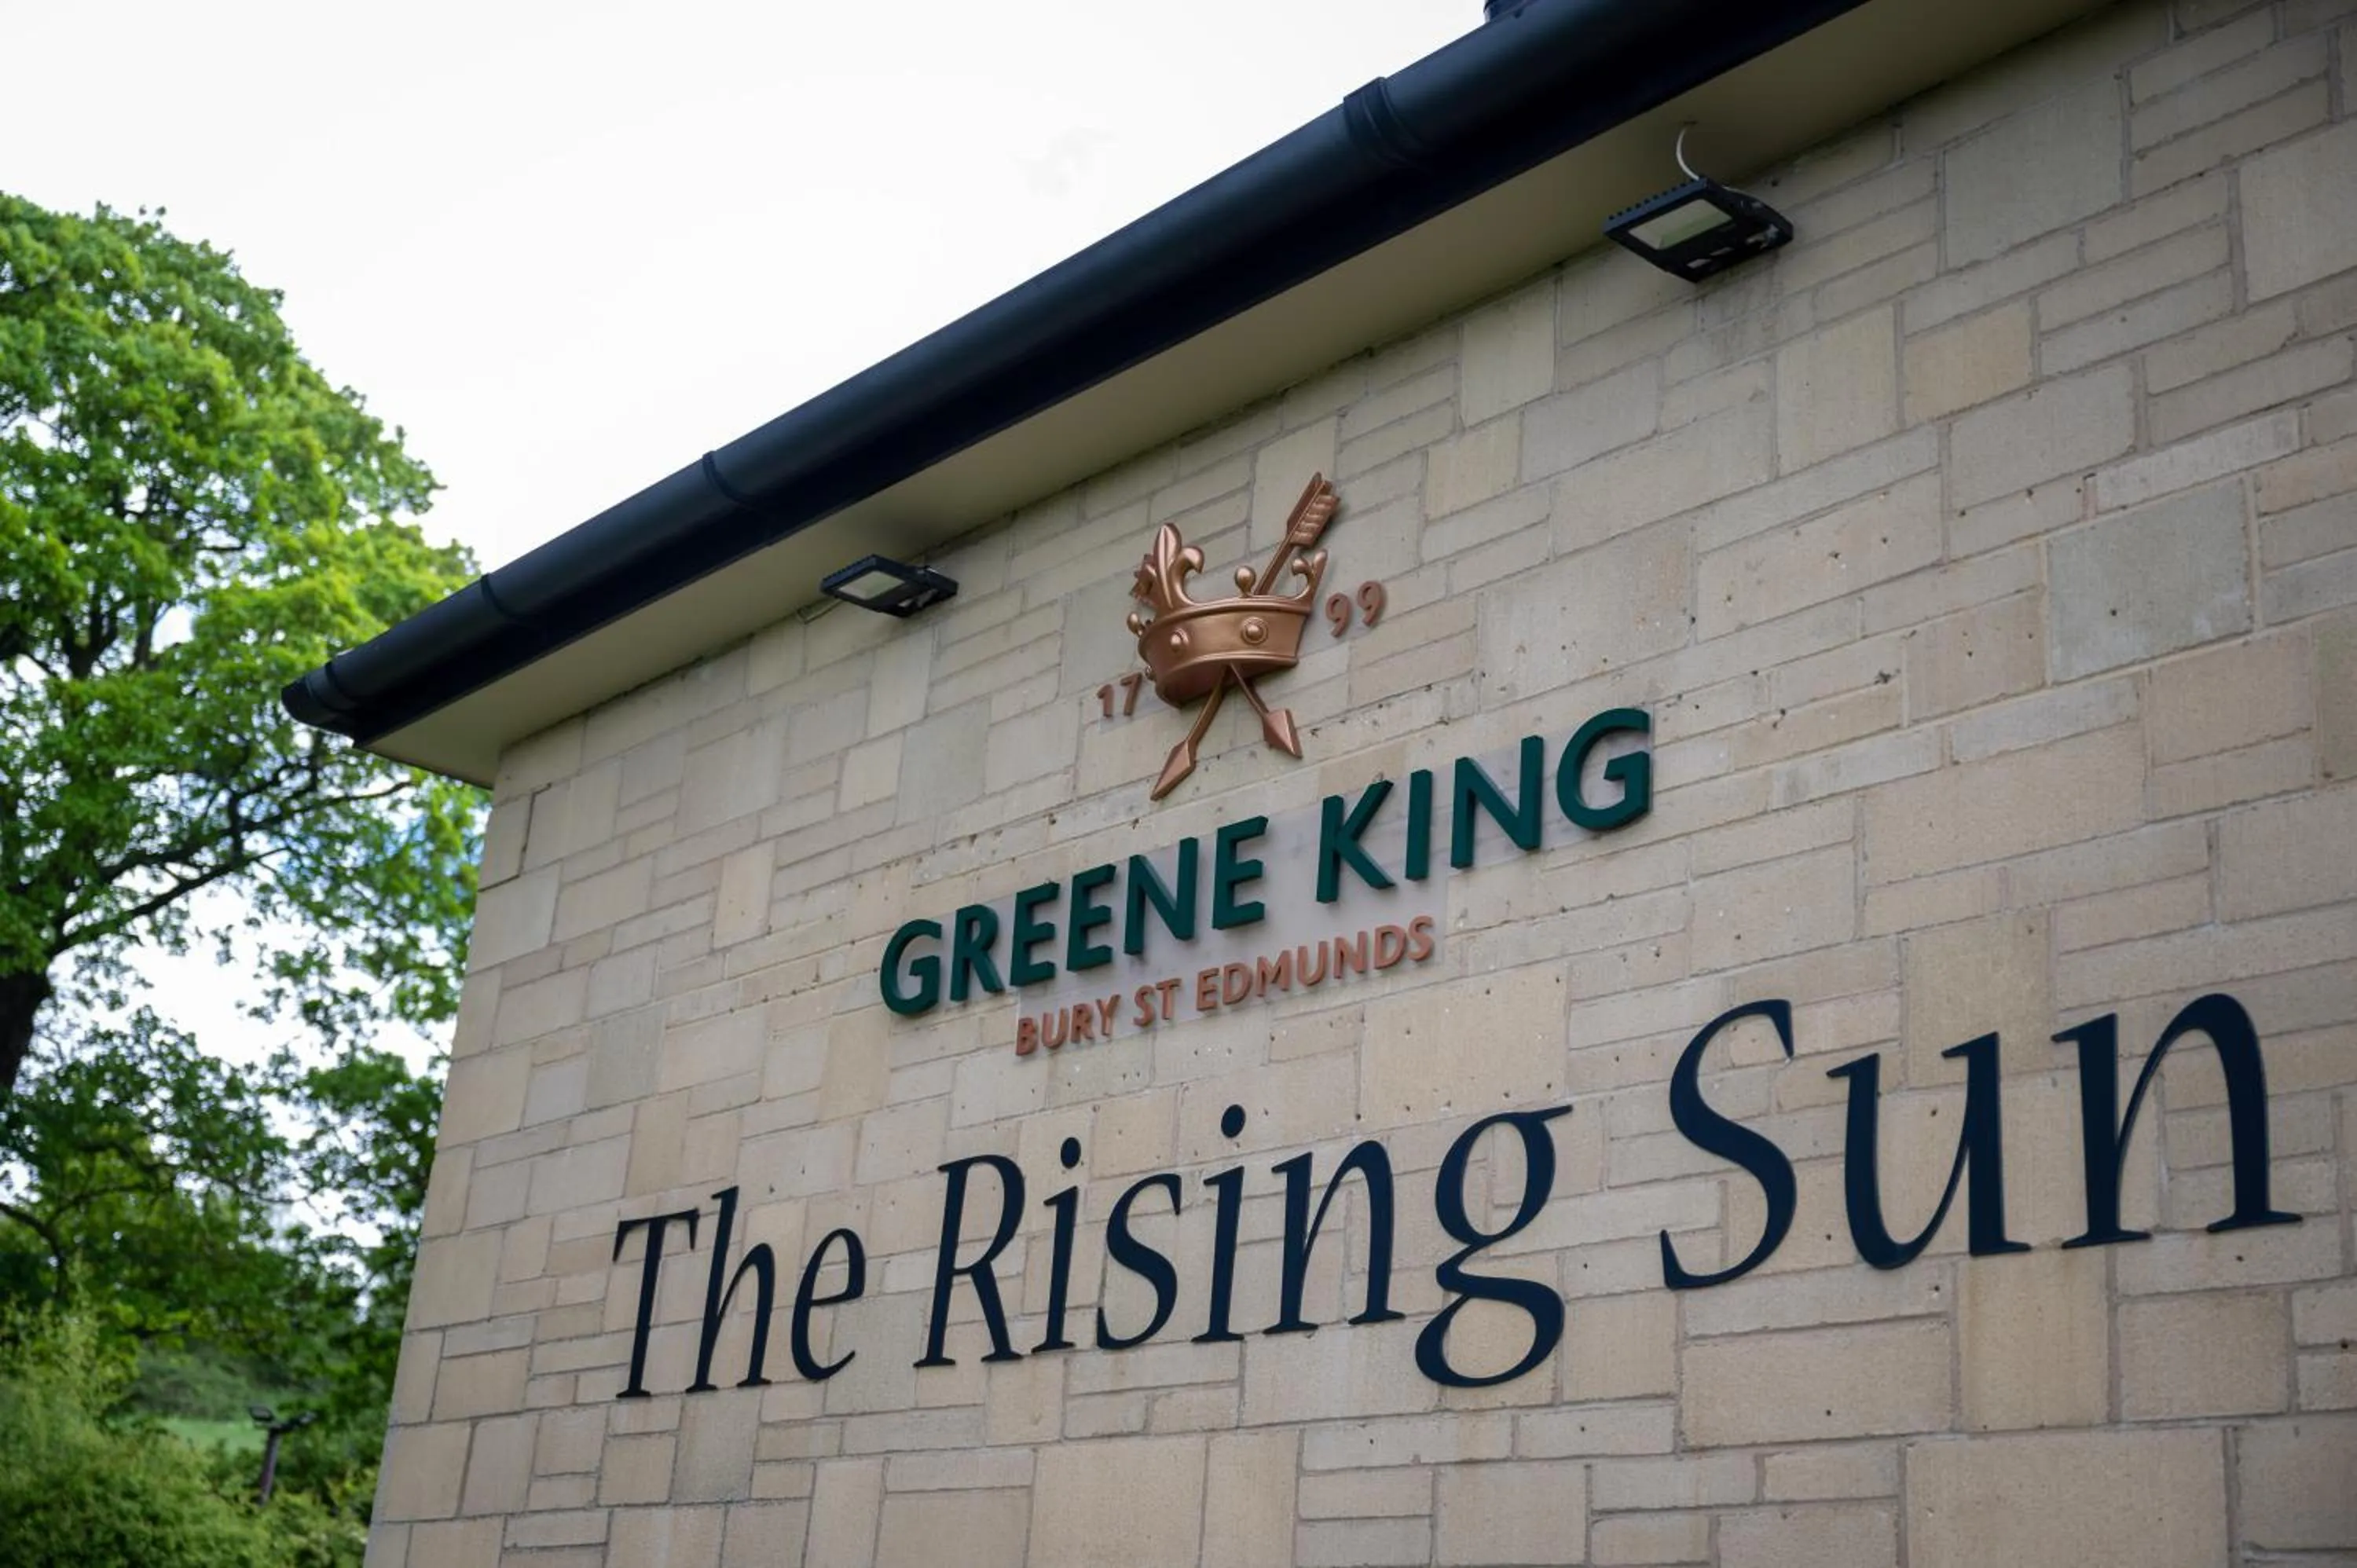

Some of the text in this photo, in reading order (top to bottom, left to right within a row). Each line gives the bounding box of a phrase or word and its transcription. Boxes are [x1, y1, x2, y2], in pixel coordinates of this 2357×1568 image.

[1098, 581, 1384, 718] 17 99
[880, 707, 1653, 1017] GREENE KING
[1016, 915, 1435, 1056] BURY ST EDMUNDS
[613, 993, 2304, 1399] The Rising Sun
